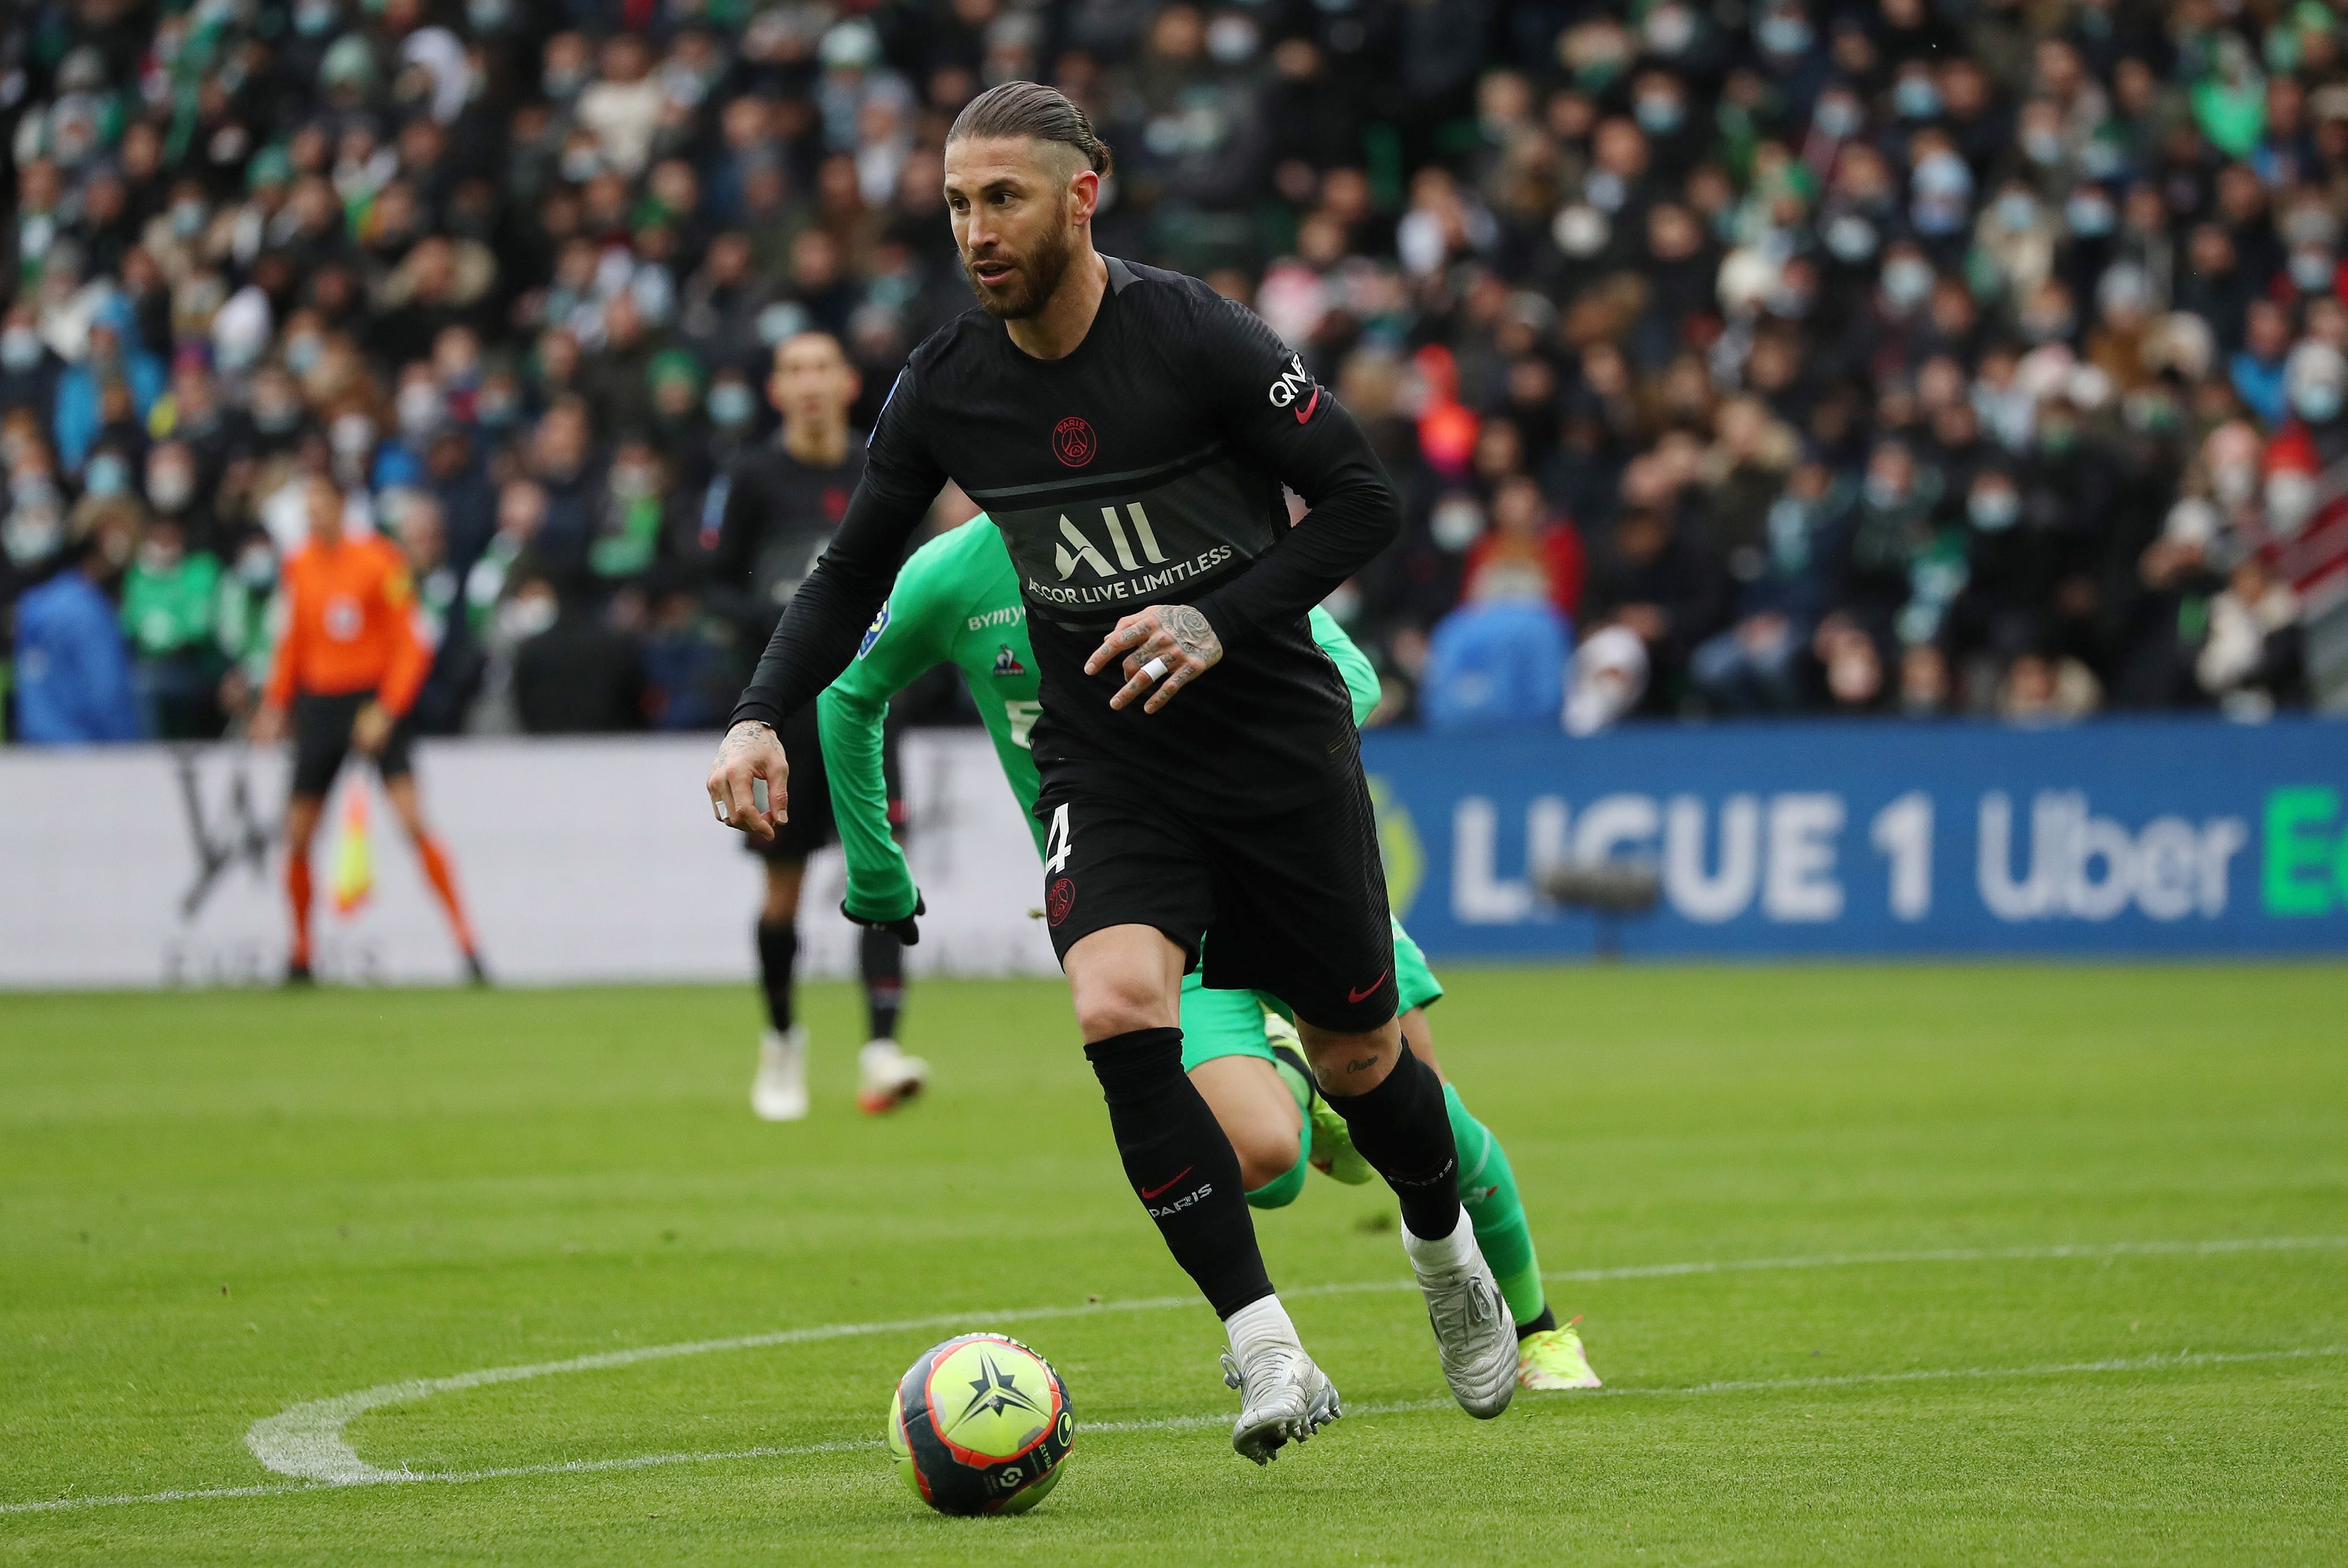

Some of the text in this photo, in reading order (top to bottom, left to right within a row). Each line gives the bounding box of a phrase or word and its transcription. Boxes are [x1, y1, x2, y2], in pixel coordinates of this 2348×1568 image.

[1057, 419, 1087, 434] PARIS
[1081, 582, 1129, 604] LIVE
[1131, 545, 1232, 595] LIMITLESS
[1045, 802, 1072, 877] 4
[1871, 792, 1933, 921] 1
[1977, 791, 2248, 921] Uber
[2262, 785, 2348, 917] E
[1148, 1183, 1213, 1218] PARIS
